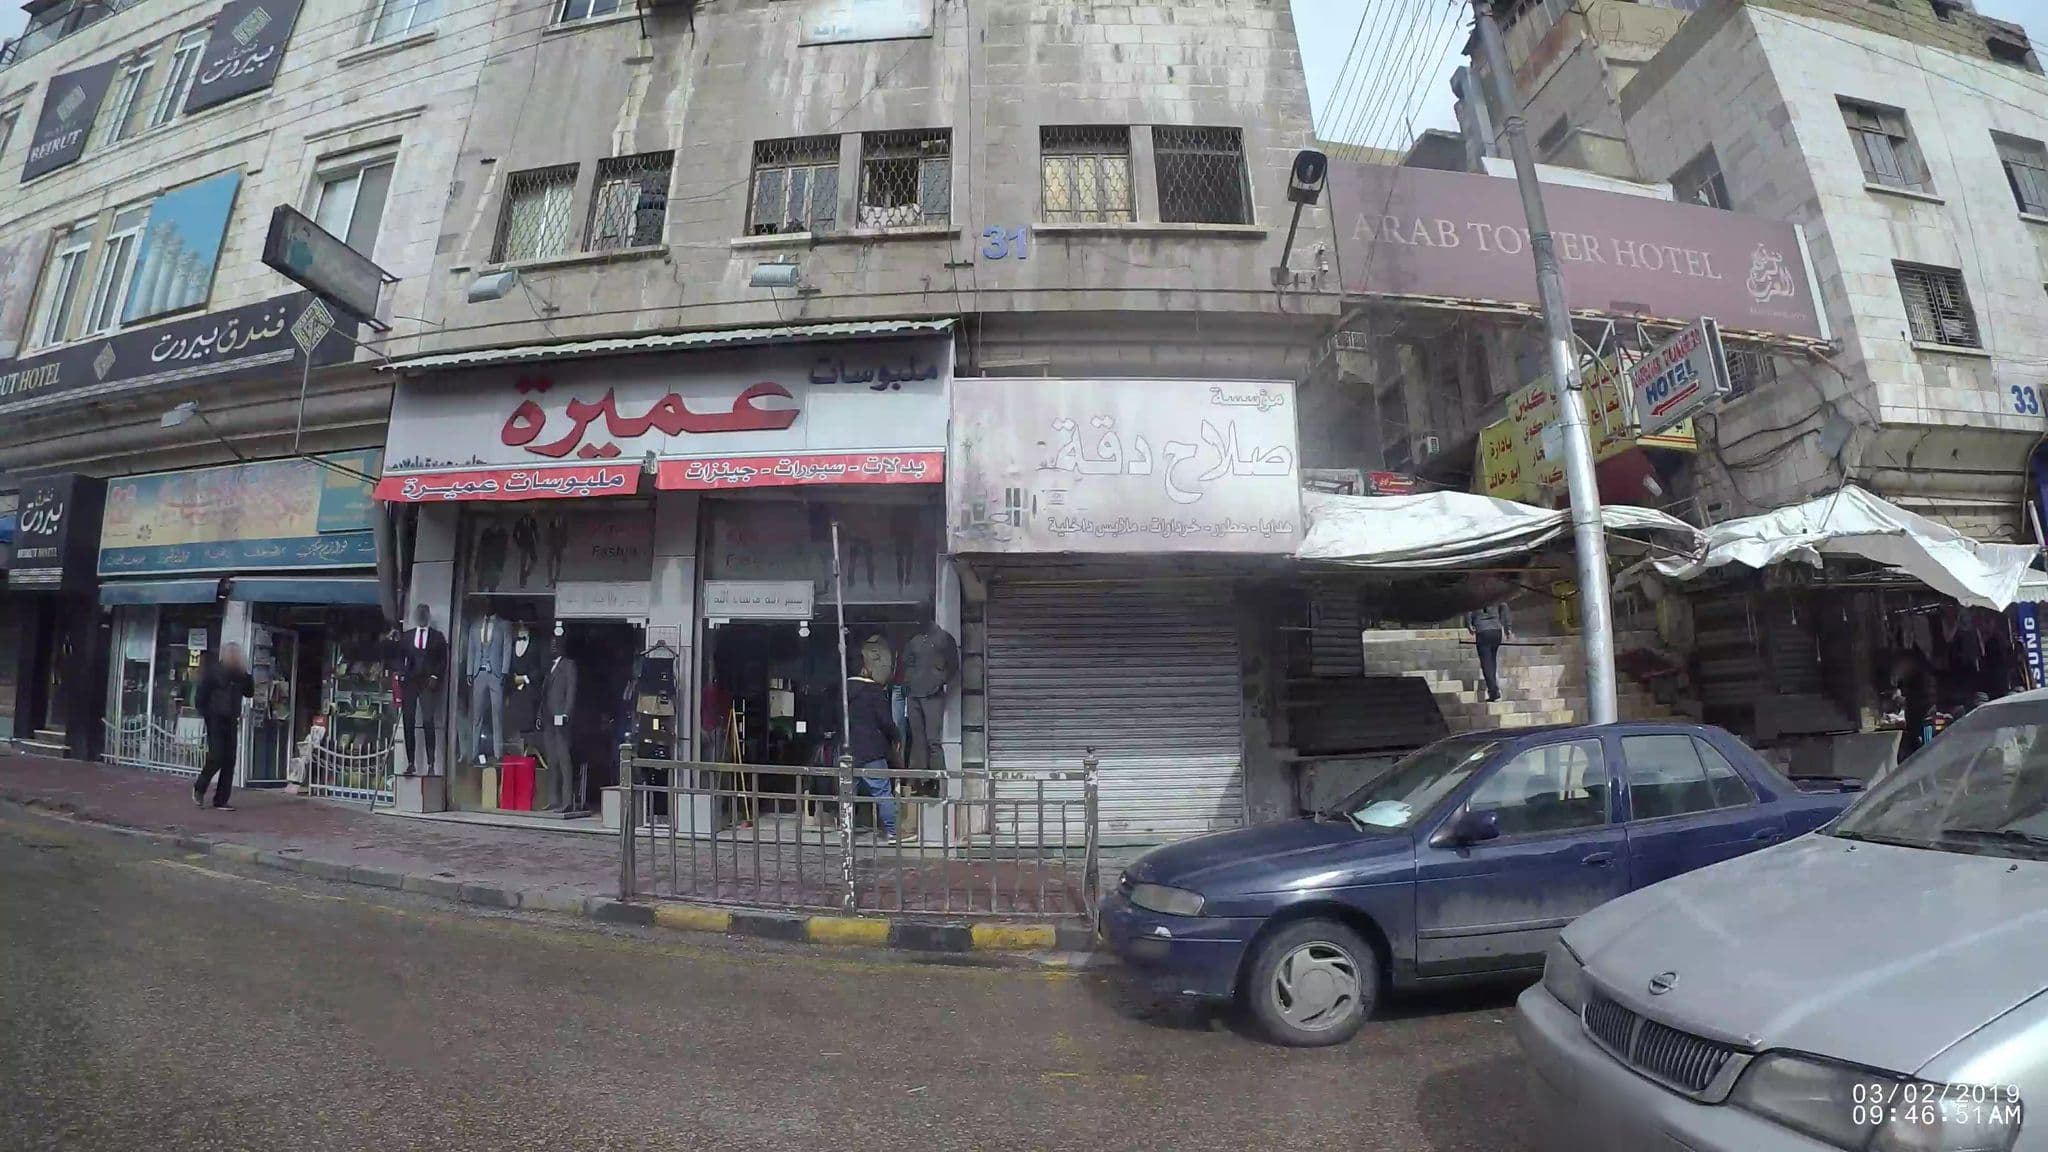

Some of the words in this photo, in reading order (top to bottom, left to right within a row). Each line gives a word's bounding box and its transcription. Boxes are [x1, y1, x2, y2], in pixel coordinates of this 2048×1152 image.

[201, 45, 275, 85] بيروت
[30, 129, 83, 162] BEIRUT
[981, 225, 1028, 260] 31
[1351, 212, 1460, 249] ARAB
[1467, 221, 1607, 265] TOER
[1611, 238, 1723, 280] HOTEL
[151, 326, 220, 363] بيروت
[216, 306, 286, 354] فندق
[17, 361, 63, 393] HOTEL
[807, 356, 939, 392] ملبوسات
[1645, 359, 1699, 406] HOTEL
[1209, 387, 1286, 413] مؤسسة
[2011, 385, 2040, 415] 33
[500, 375, 801, 459] عميرة
[1051, 414, 1154, 476] دقة
[1163, 418, 1294, 505] صلاح
[503, 469, 627, 495] ملبوسات
[685, 461, 756, 483] جينزات
[773, 458, 846, 481] سبورات
[861, 456, 927, 478] بدلات
[401, 477, 500, 500] عميرة
[20, 502, 63, 535] بيروت
[1048, 516, 1095, 537] داخلية
